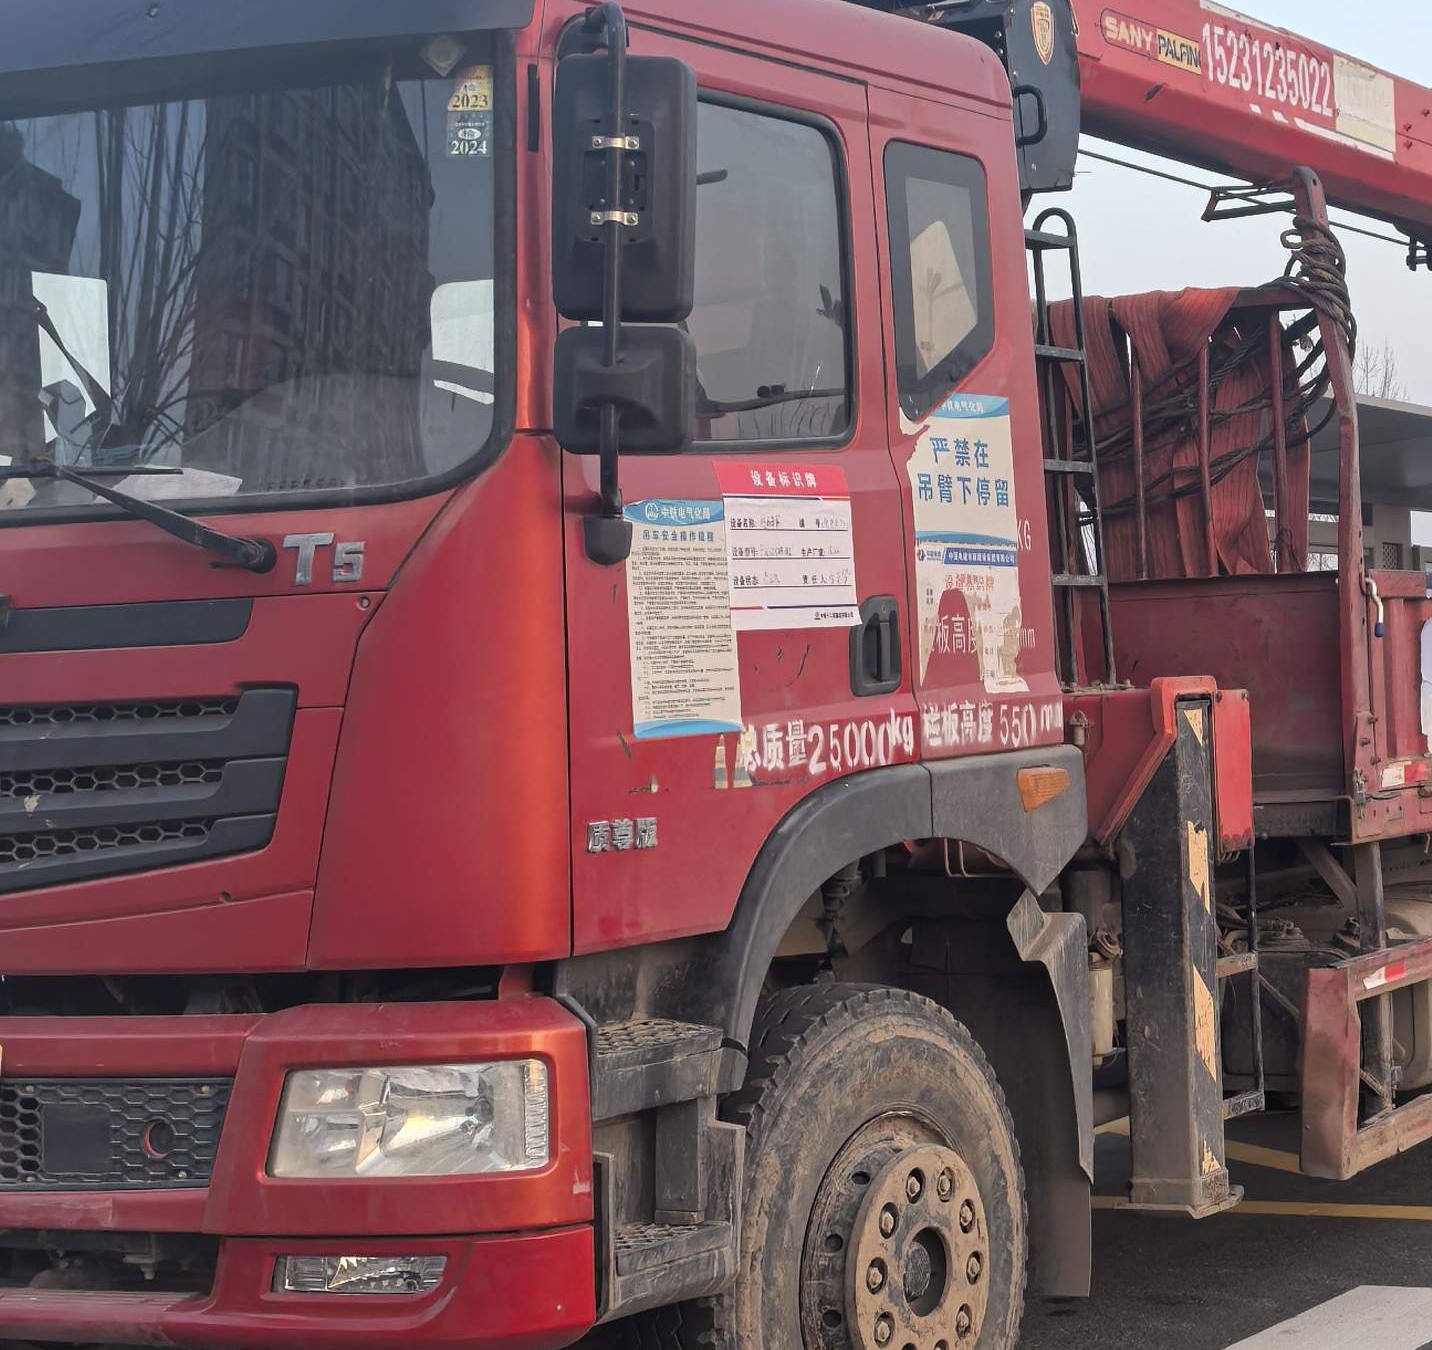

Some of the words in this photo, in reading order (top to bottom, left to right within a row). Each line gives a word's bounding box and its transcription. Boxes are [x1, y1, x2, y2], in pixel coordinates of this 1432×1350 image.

[1104, 16, 1153, 51] SANY
[1157, 33, 1201, 70] PALFIN
[1202, 22, 1334, 118] 15231235022
[451, 94, 489, 109] 2023
[450, 140, 488, 155] 2024
[930, 437, 990, 469] 严禁在
[750, 469, 818, 489] 设备标识牌
[917, 473, 1009, 508] 吊臂下停留
[282, 532, 369, 586] T5
